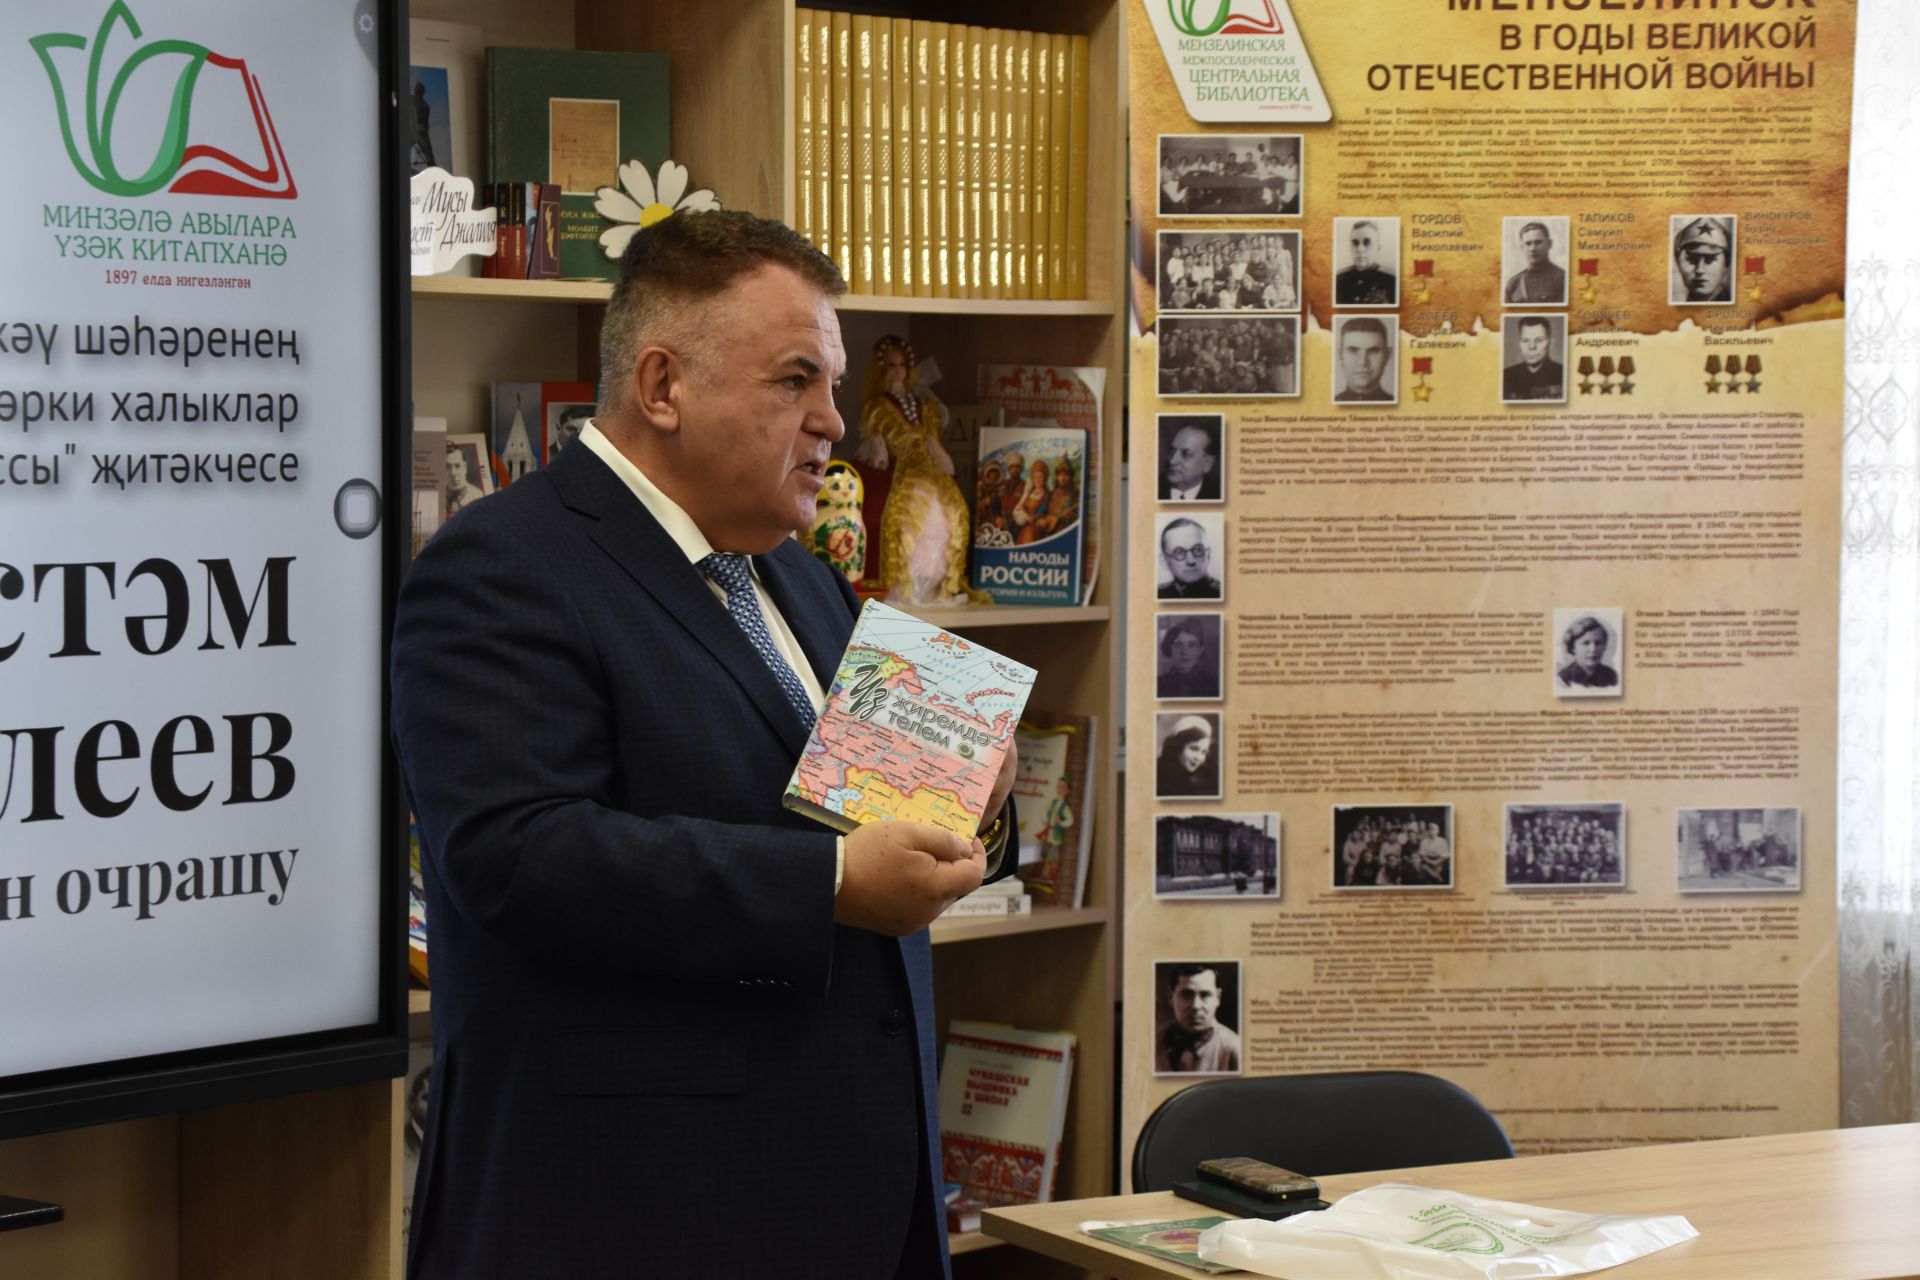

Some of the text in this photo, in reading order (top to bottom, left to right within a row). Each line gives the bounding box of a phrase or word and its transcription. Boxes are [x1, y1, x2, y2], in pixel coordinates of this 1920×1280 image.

[1178, 38, 1285, 52] МЕНЗЕЛИНСКАЯ
[1501, 15, 1816, 55] В ГОДЫ ВЕЛИКОЙ
[1182, 55, 1295, 66] МЕЖПОСЕЛЕНЧЕСКАЯ
[1189, 68, 1300, 84] ЦЕНТРАЛЬНАЯ
[1367, 57, 1814, 92] ОТЕЧЕСТВЕННОЙ ВОЙНЫ
[1196, 86, 1310, 102] БИБЛИОТЕКА
[422, 181, 468, 231] Мусы
[43, 204, 297, 239] МИНЗӘЛӘ АВЫЛАРА
[1412, 213, 1462, 225] ГОРДОВ
[1579, 213, 1636, 223] ТАПИКОВ
[1578, 227, 1624, 239] Самуил
[54, 234, 288, 266] ҮЗӘК КИТАПХАНӘ
[1412, 242, 1484, 252] Николаевич
[105, 270, 251, 289] 1897 елда нигезләнгән
[75, 315, 300, 366] шәһәренең
[111, 390, 299, 433] халыклар
[91, 451, 300, 491] җитәкчесе
[1008, 551, 1070, 566] НАРОДЫ
[979, 565, 1069, 587] РОССИИ
[56, 848, 300, 921] очрашу
